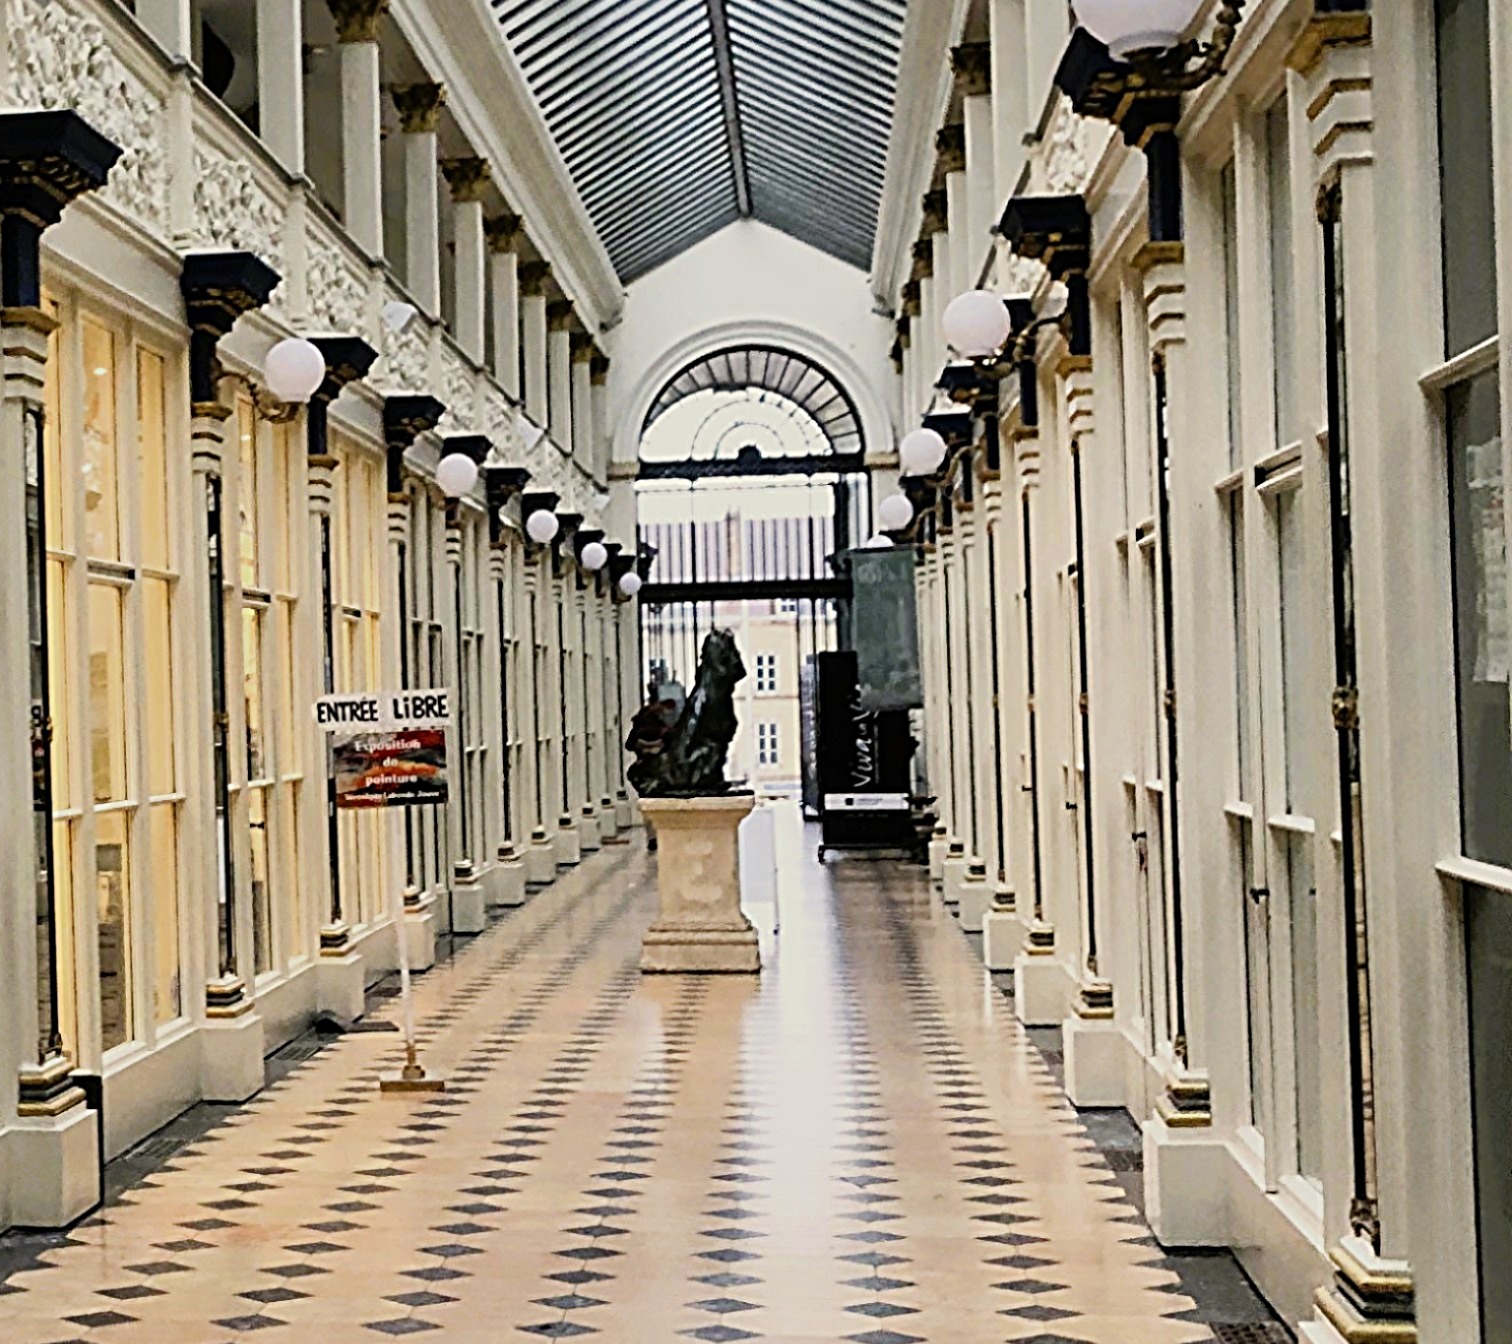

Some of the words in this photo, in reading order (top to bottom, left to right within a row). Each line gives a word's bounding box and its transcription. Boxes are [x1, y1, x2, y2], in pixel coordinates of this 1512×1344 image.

[317, 696, 379, 723] ENTRÉE
[354, 738, 421, 753] Exposition
[383, 756, 399, 767] de
